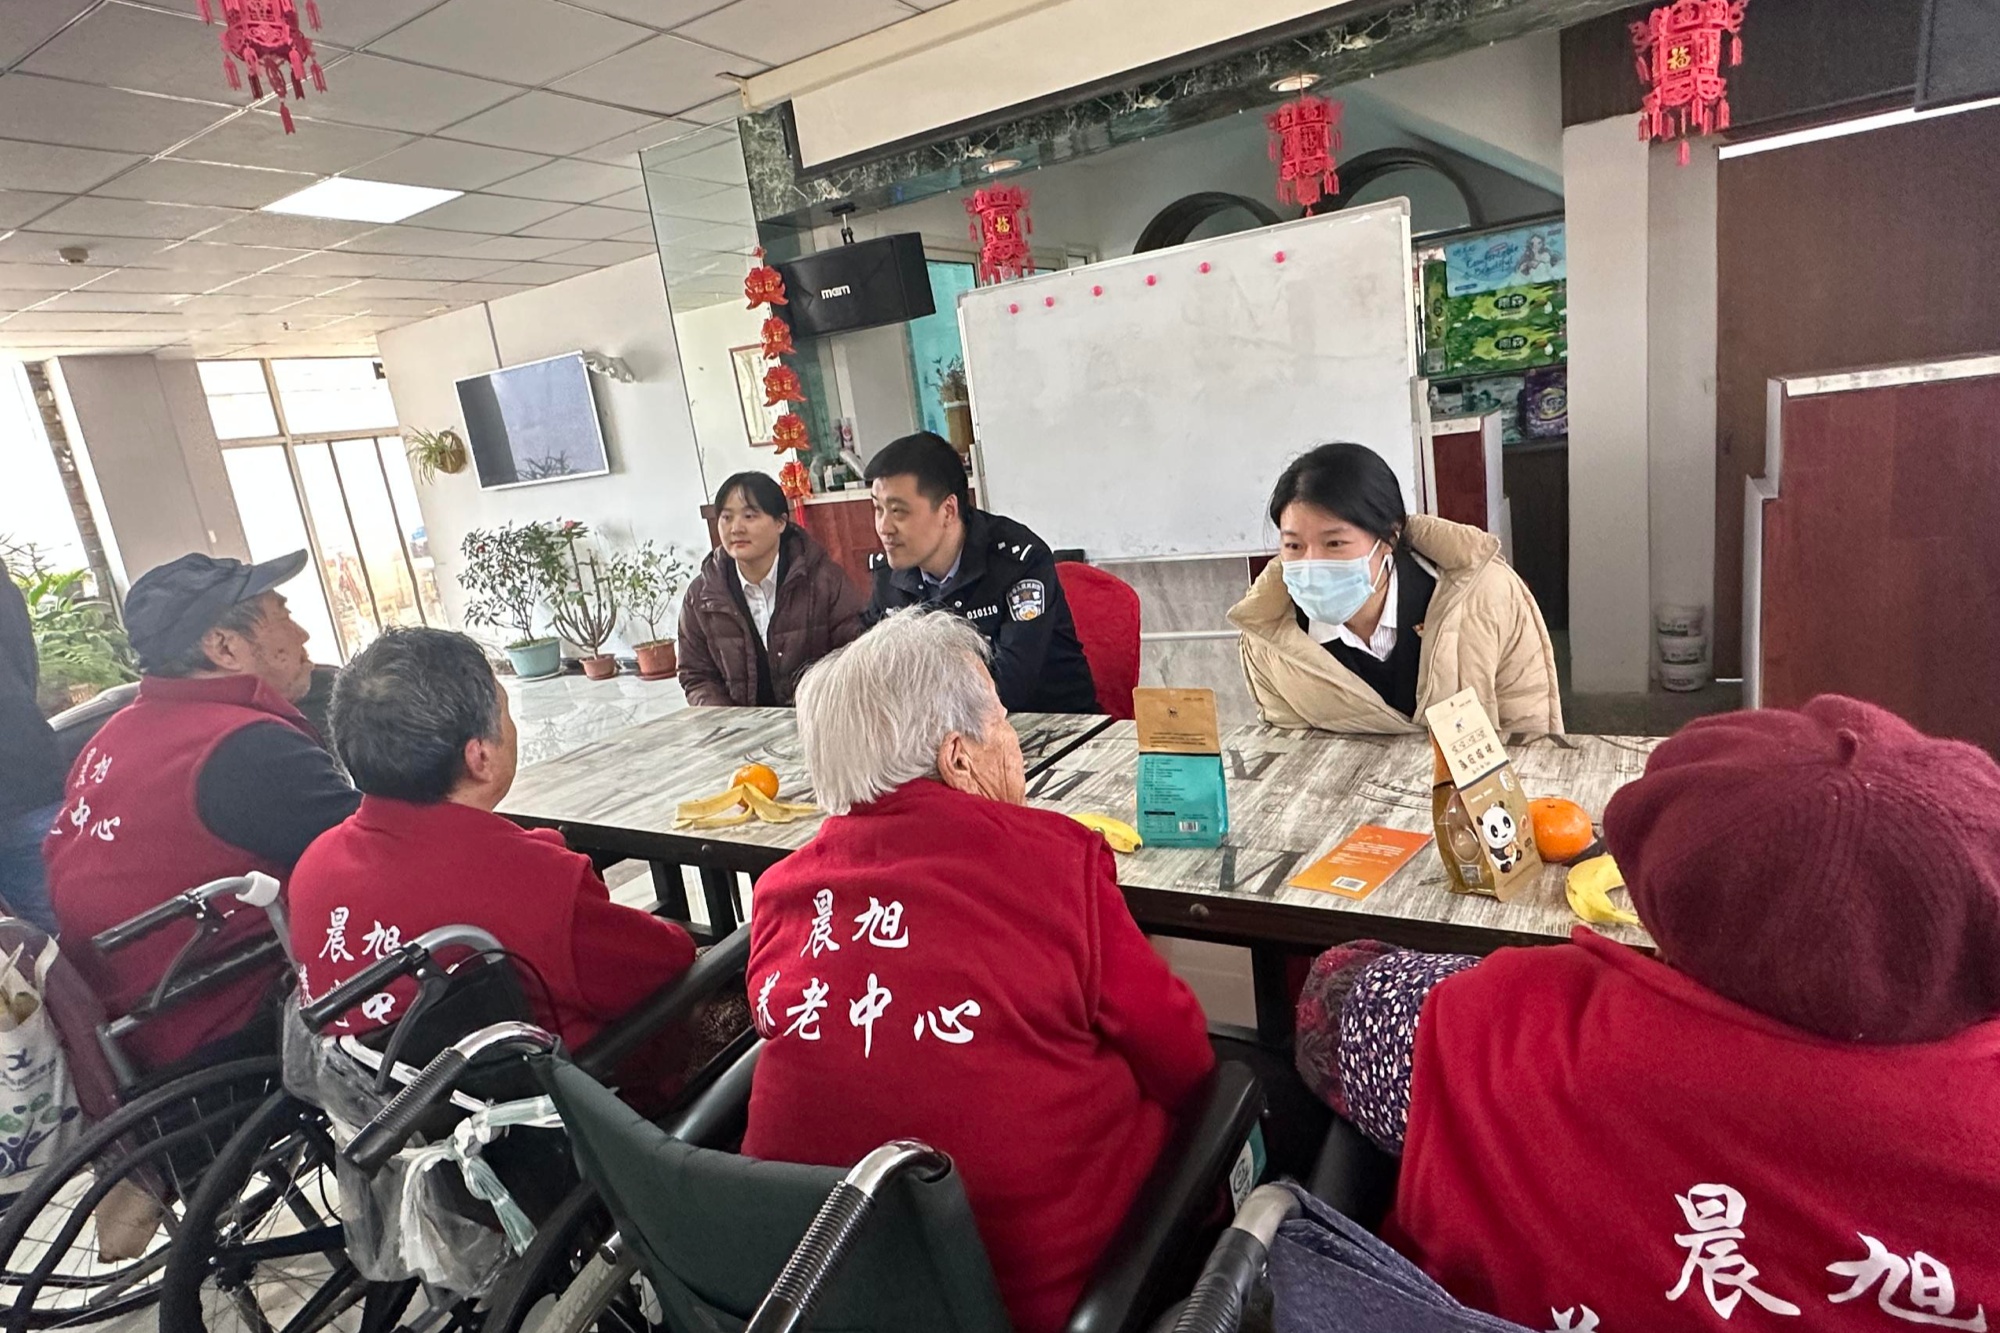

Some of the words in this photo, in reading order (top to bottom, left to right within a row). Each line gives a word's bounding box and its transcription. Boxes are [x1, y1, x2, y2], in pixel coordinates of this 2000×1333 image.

[1667, 46, 1691, 70] 福
[966, 604, 998, 620] 010110
[318, 906, 401, 963] 晨旭
[800, 888, 909, 959] 晨旭
[757, 970, 982, 1059] 养老中心
[1665, 1183, 1988, 1332] 晨旭
